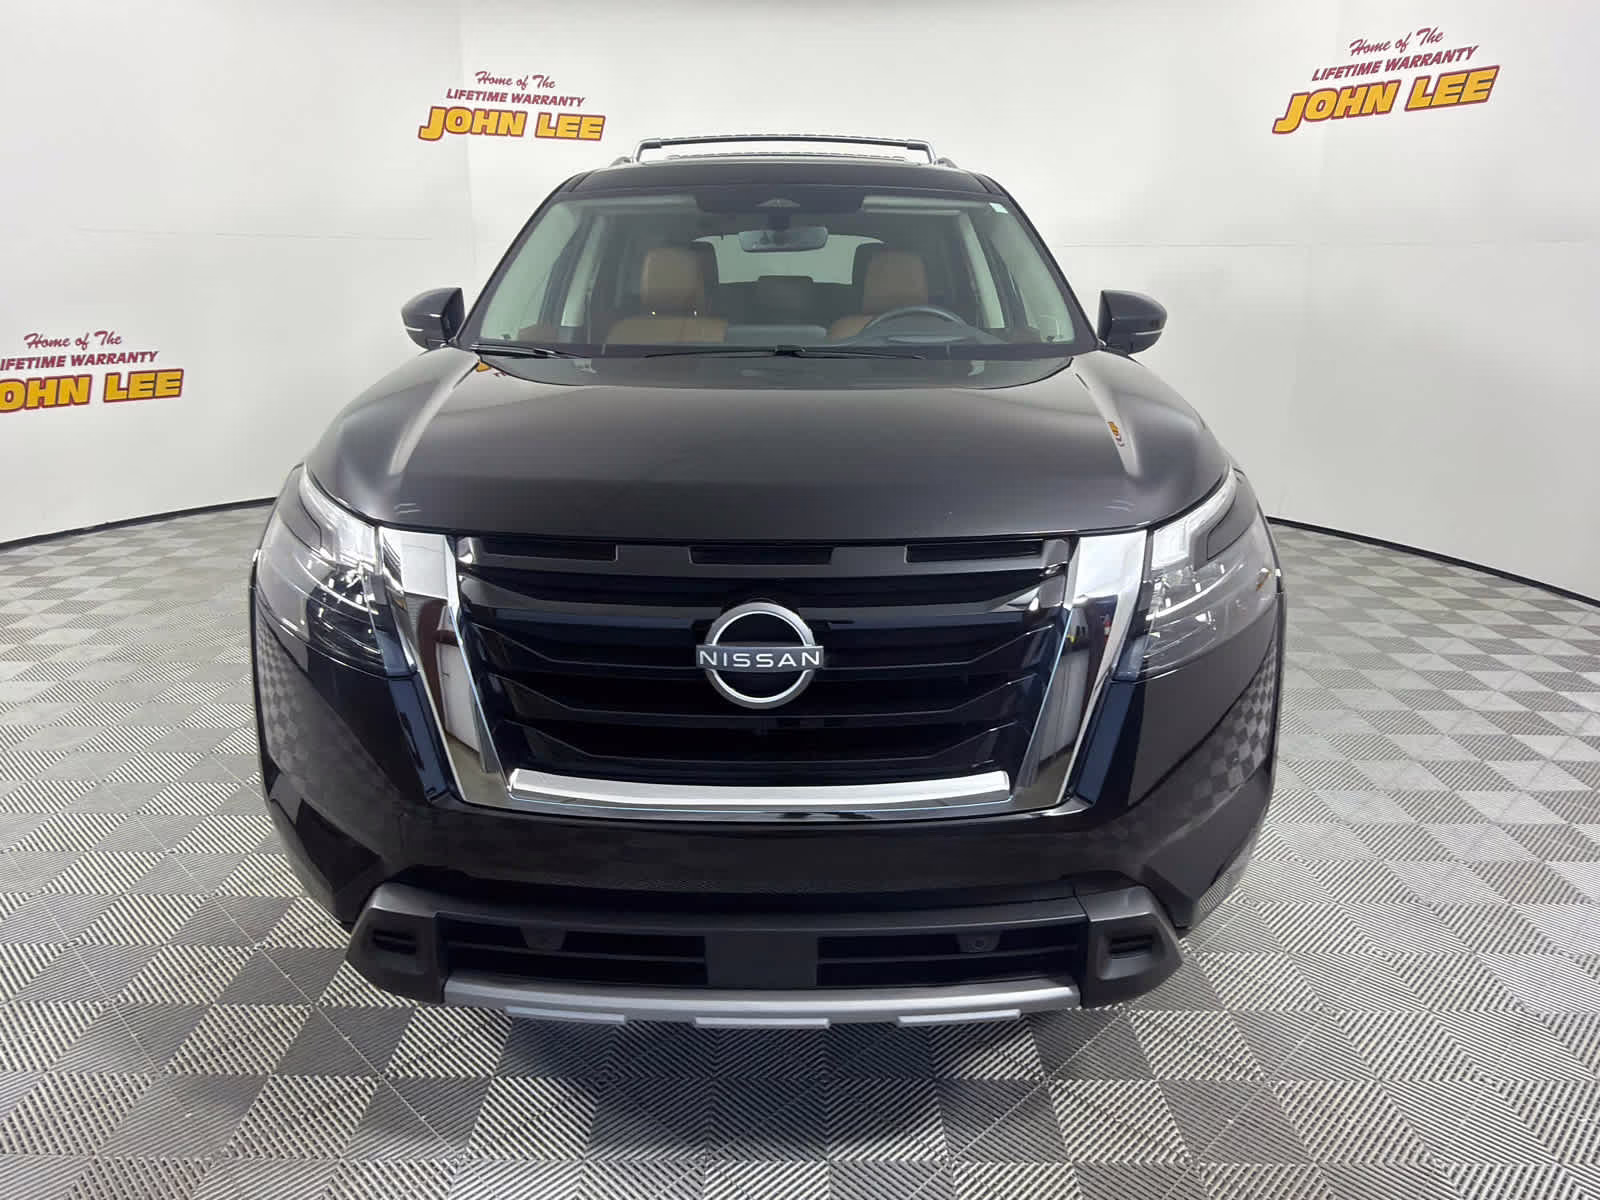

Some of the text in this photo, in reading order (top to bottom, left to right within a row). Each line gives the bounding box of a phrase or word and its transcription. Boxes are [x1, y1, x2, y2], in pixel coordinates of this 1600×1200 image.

[1350, 26, 1444, 56] Home of The
[1312, 45, 1479, 81] LIFETIME WARRANTY
[475, 71, 556, 90] Home of The
[446, 88, 586, 107] LIFETIME WARRANTY
[1272, 64, 1500, 134] JOHN LEE
[418, 106, 606, 141] JOHN LEE
[24, 331, 122, 350] Home of The
[0, 351, 159, 371] IFETIME WARRANTY
[0, 369, 184, 413] OHN LEE
[699, 650, 820, 668] NISSAN
